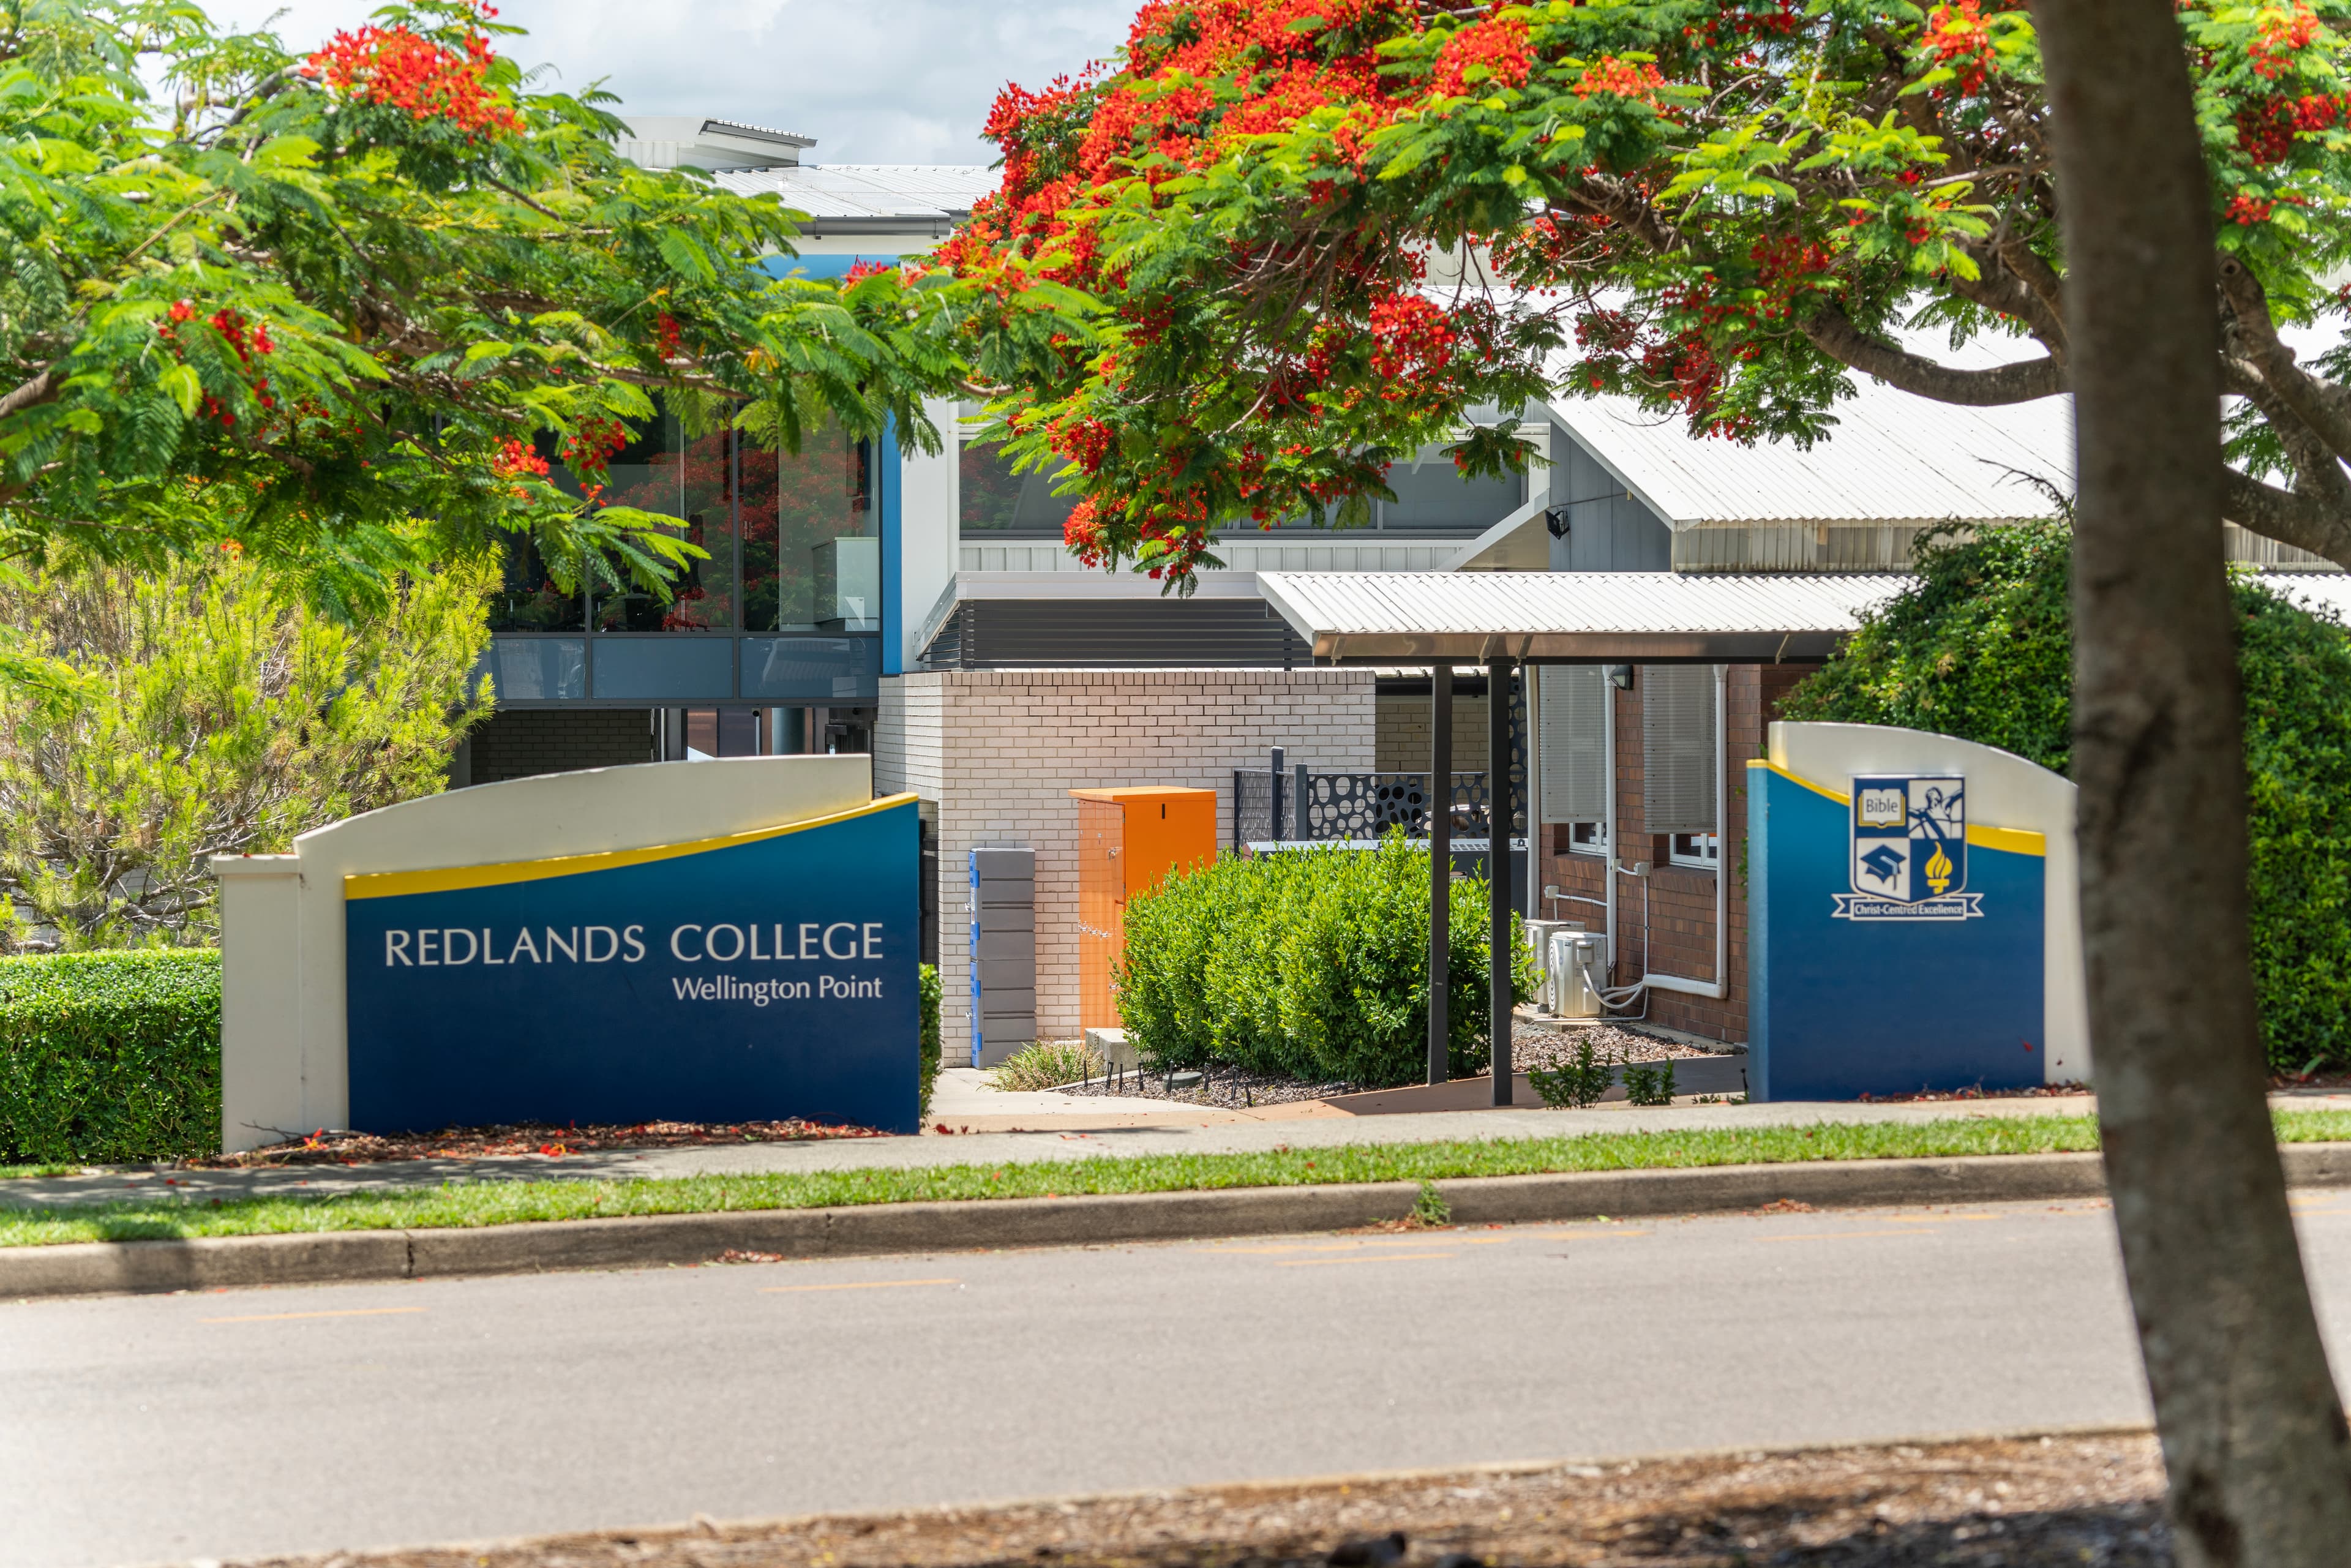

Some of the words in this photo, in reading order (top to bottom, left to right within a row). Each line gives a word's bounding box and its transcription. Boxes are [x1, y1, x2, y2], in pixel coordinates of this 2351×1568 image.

[1866, 798, 1898, 812] Bible
[1854, 904, 1917, 915] Christ-Centred
[1918, 904, 1963, 915] Excellence
[386, 925, 645, 966] REDLANDS
[670, 922, 883, 962] COLLEGE
[672, 975, 810, 1007] Wellington
[819, 975, 883, 999] Point
